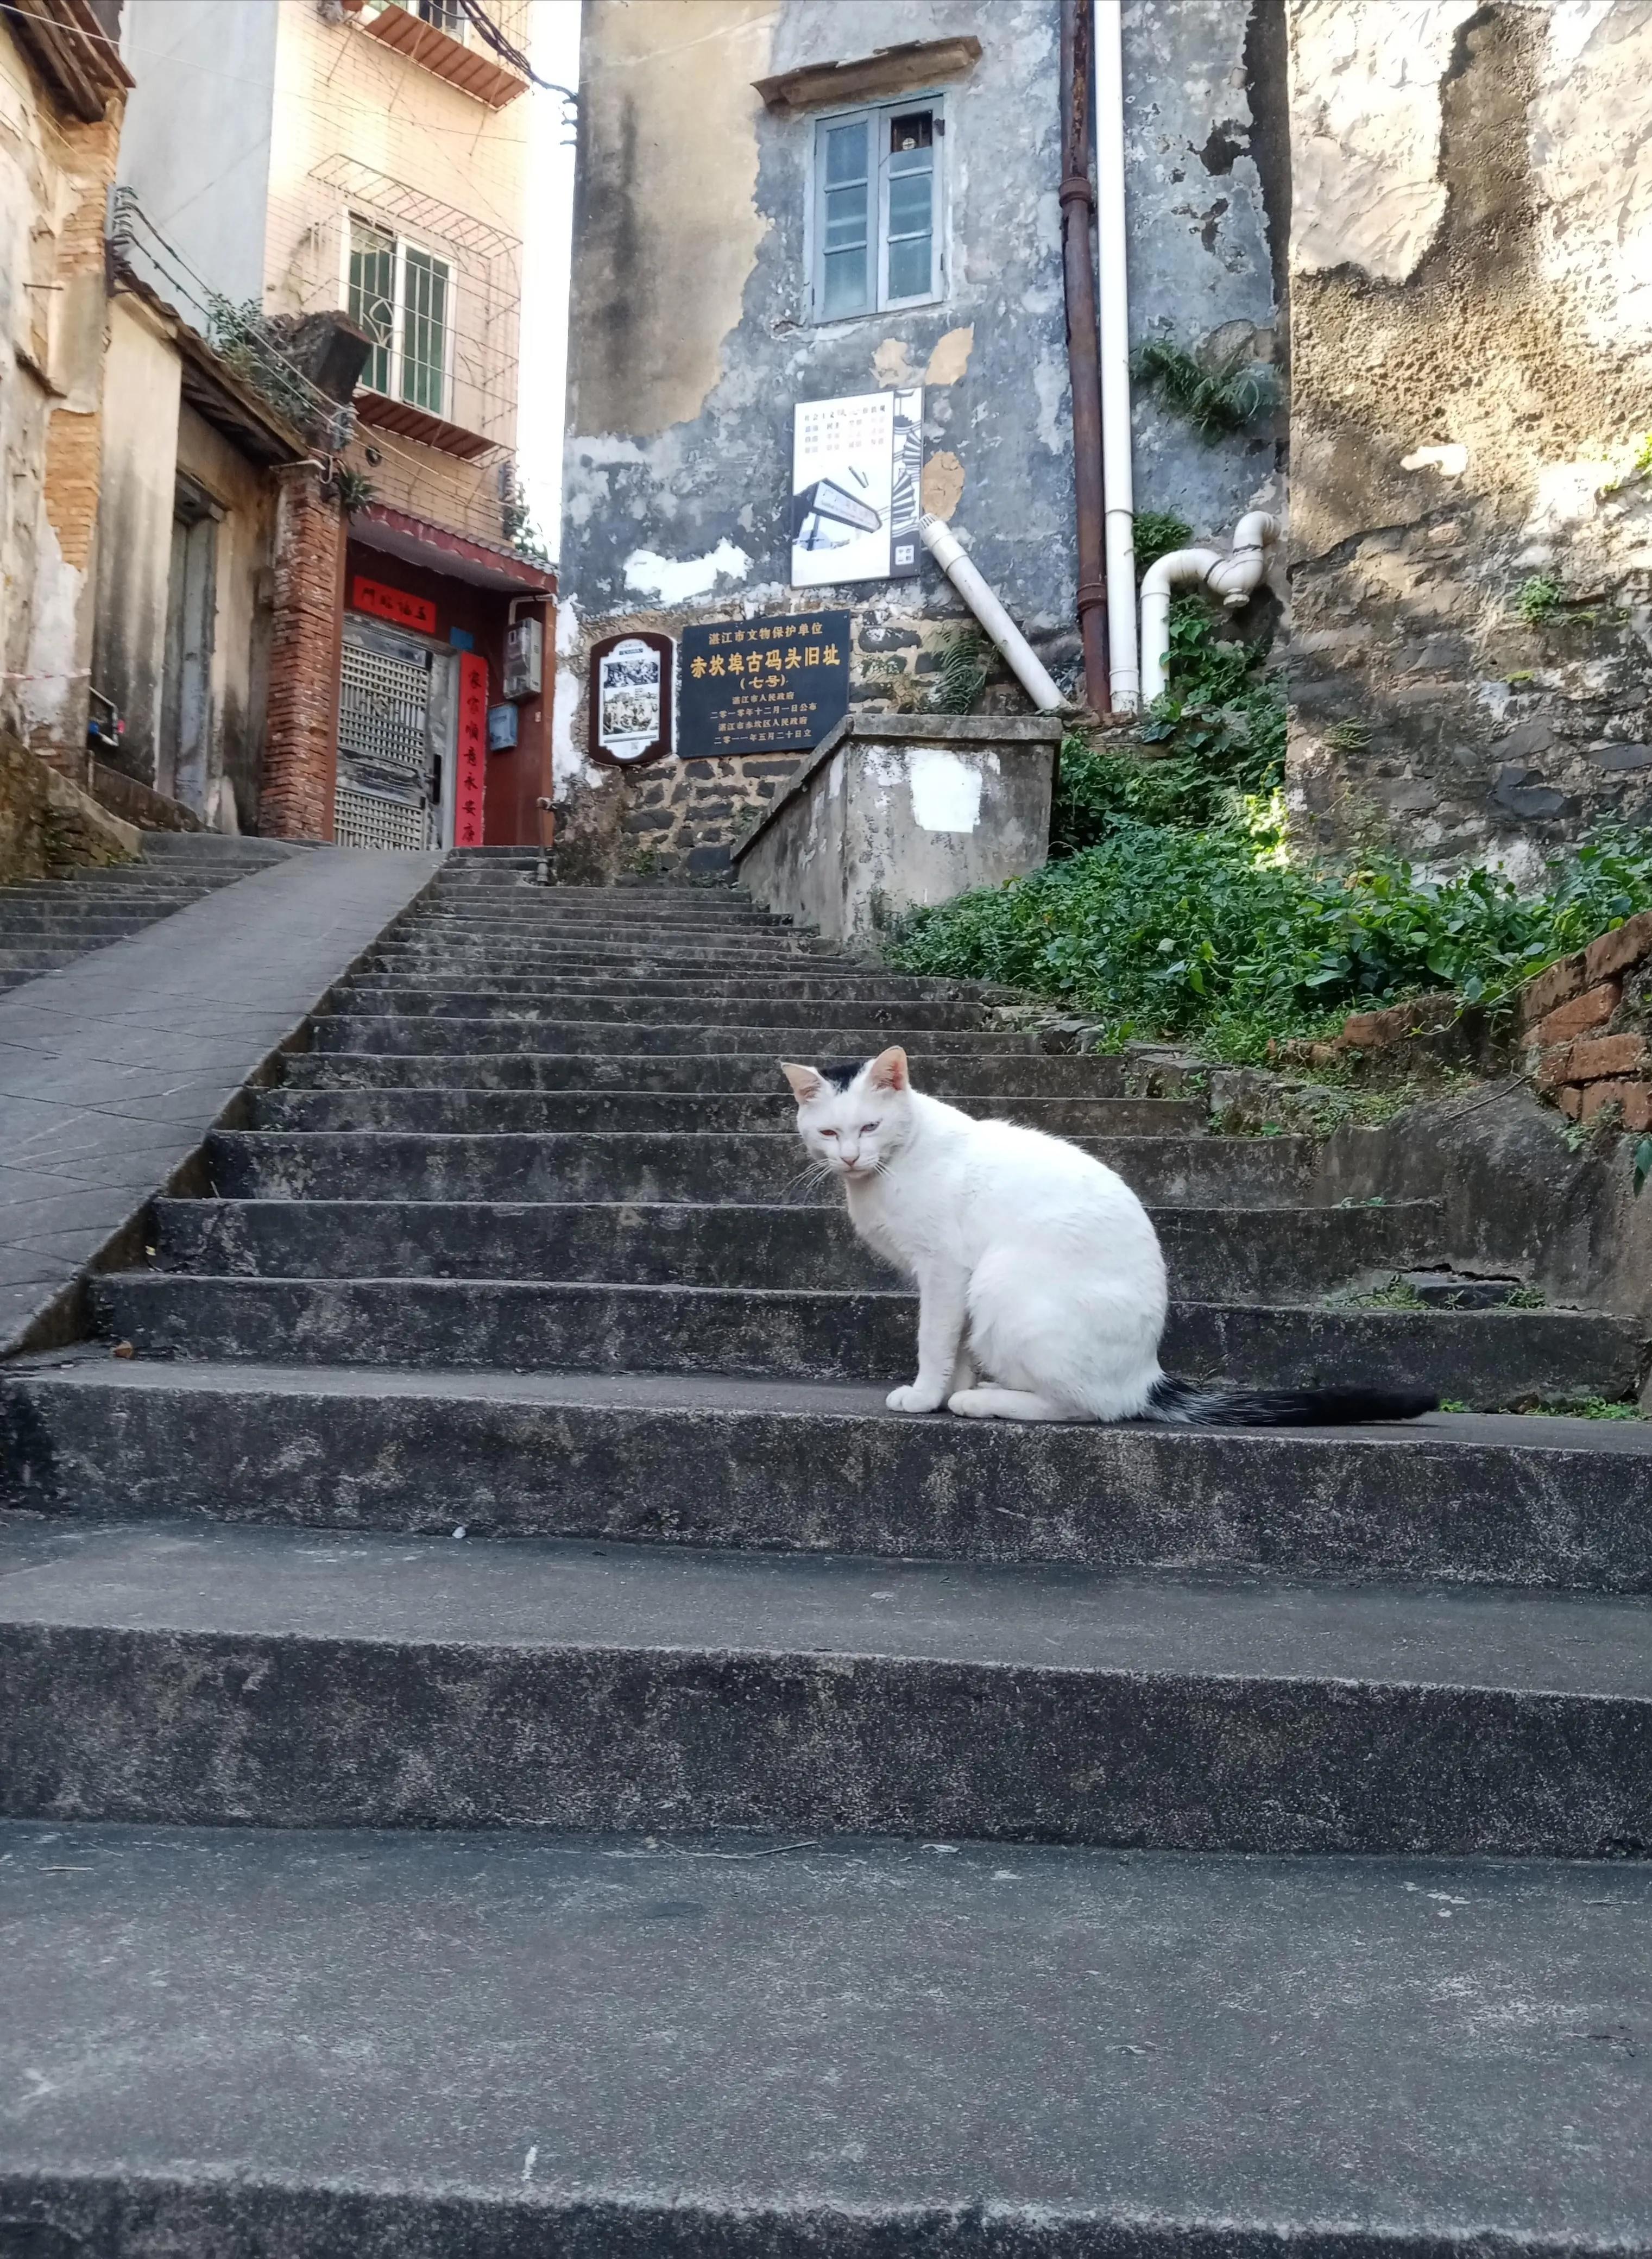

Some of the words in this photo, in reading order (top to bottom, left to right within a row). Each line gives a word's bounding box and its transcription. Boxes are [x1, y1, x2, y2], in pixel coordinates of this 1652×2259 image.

[709, 622, 823, 645] 湛江市文物保护单位
[690, 643, 841, 678] 赤坎埠古码头旧址
[732, 692, 795, 704] 湛江市人民政府
[710, 703, 817, 719] 二零一零年十二月一日公布
[718, 717, 808, 731] 湛江市赤坎区人民政府
